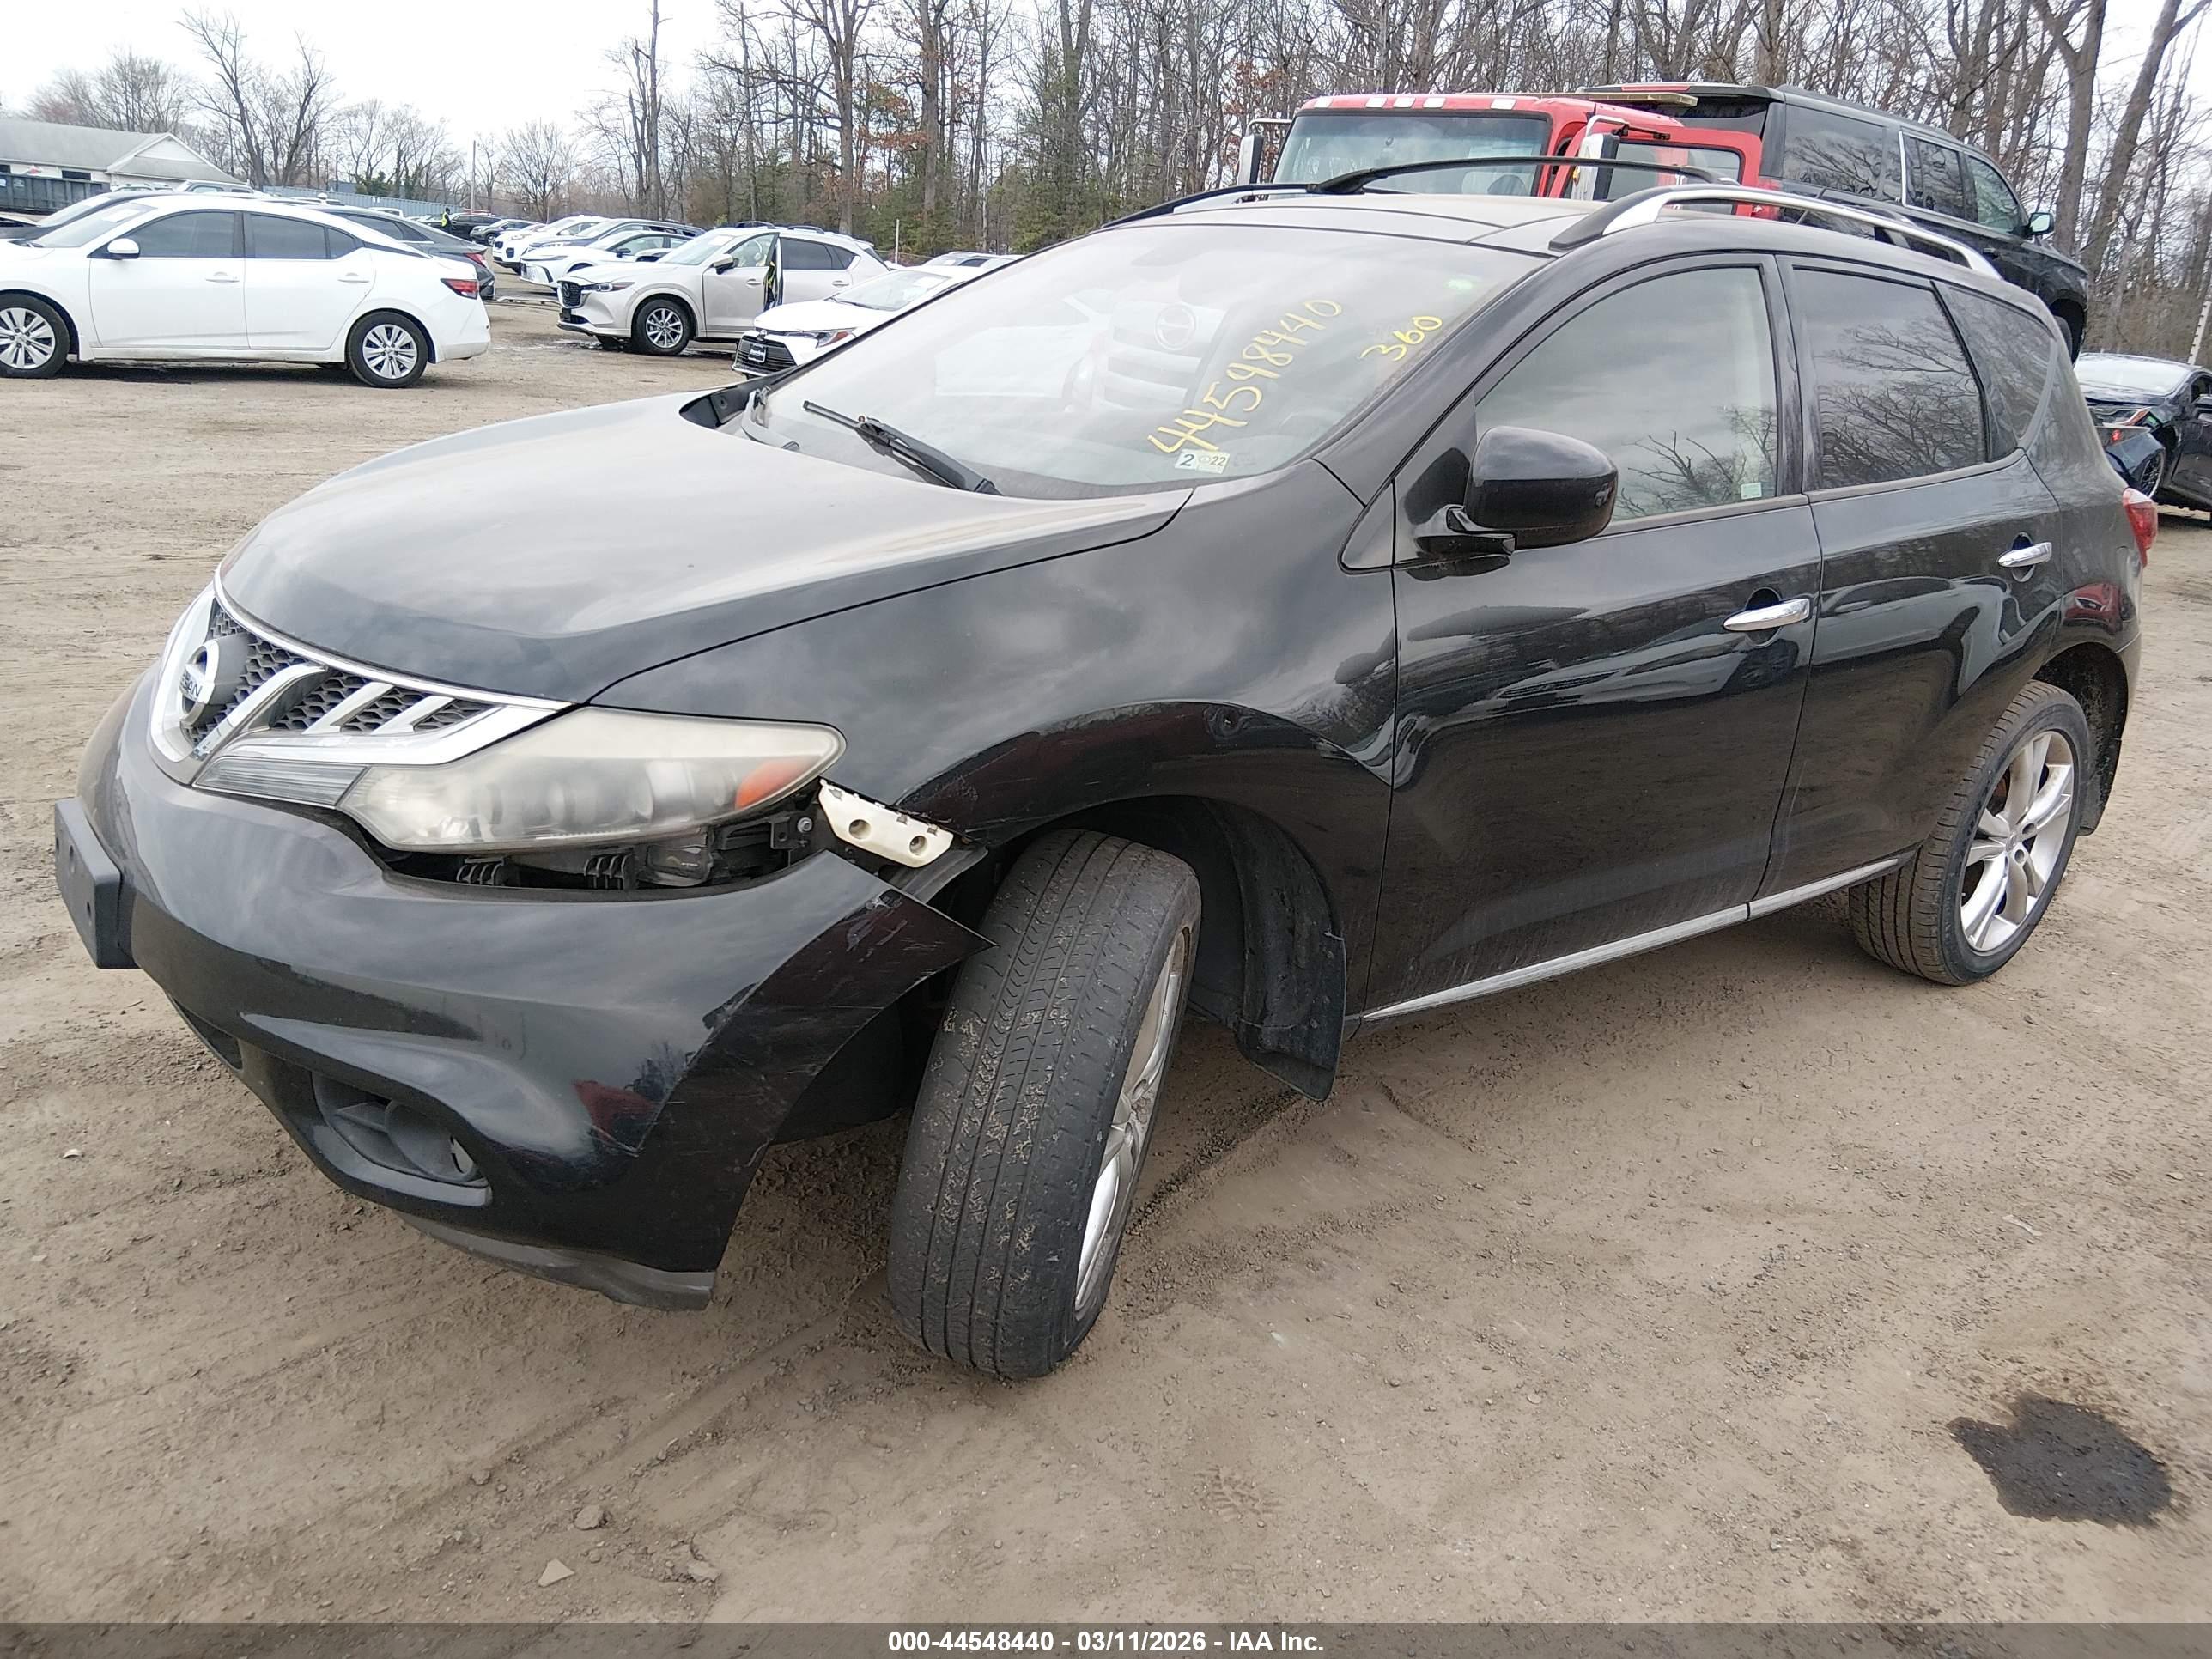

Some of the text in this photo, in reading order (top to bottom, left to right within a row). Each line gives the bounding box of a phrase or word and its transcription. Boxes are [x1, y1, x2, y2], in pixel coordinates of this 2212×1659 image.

[1358, 315, 1443, 362] 360
[1180, 453, 1194, 466] 2
[1209, 456, 1226, 467] 22
